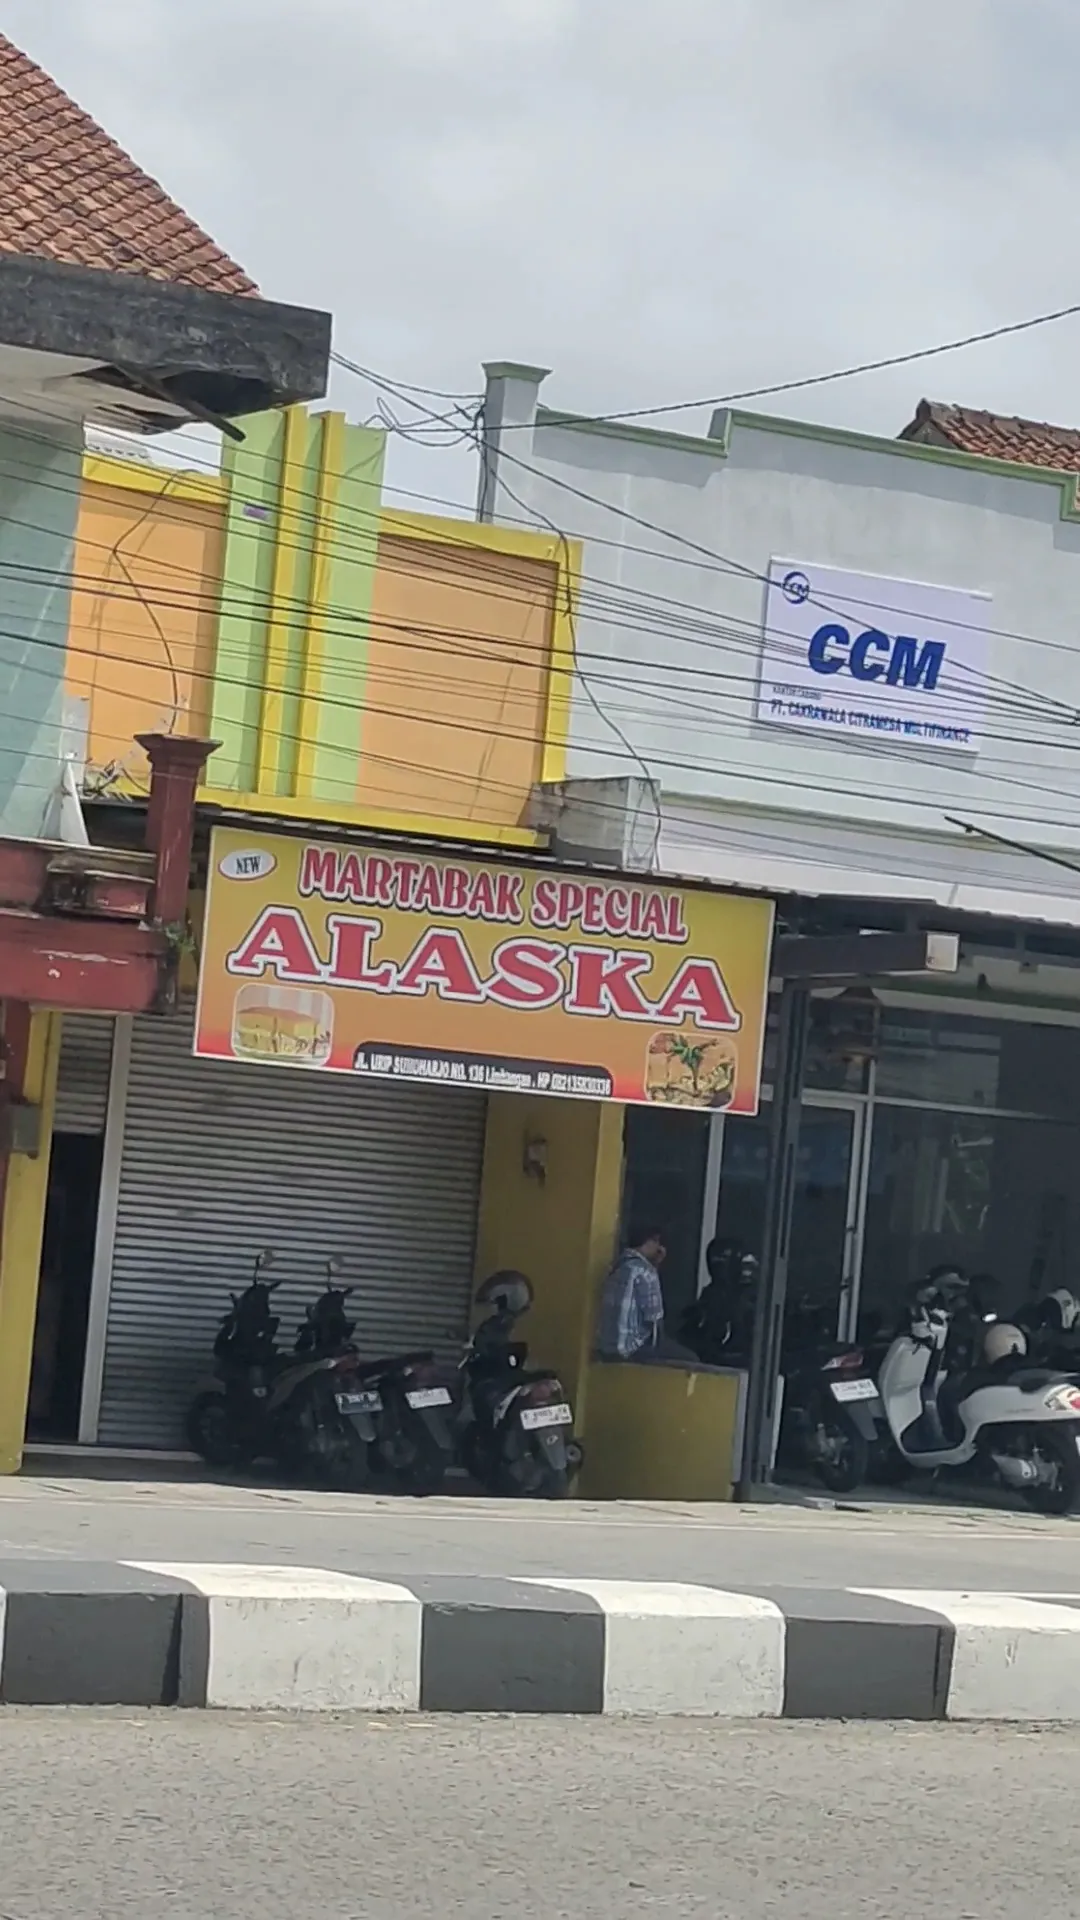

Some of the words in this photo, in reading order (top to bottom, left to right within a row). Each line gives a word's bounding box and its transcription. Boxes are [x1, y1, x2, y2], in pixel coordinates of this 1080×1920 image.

[808, 624, 946, 690] CCM
[235, 855, 261, 874] NEW
[299, 845, 523, 922] MARTABAK
[531, 878, 690, 942] SPECIAL
[226, 904, 742, 1031] ALASKA
